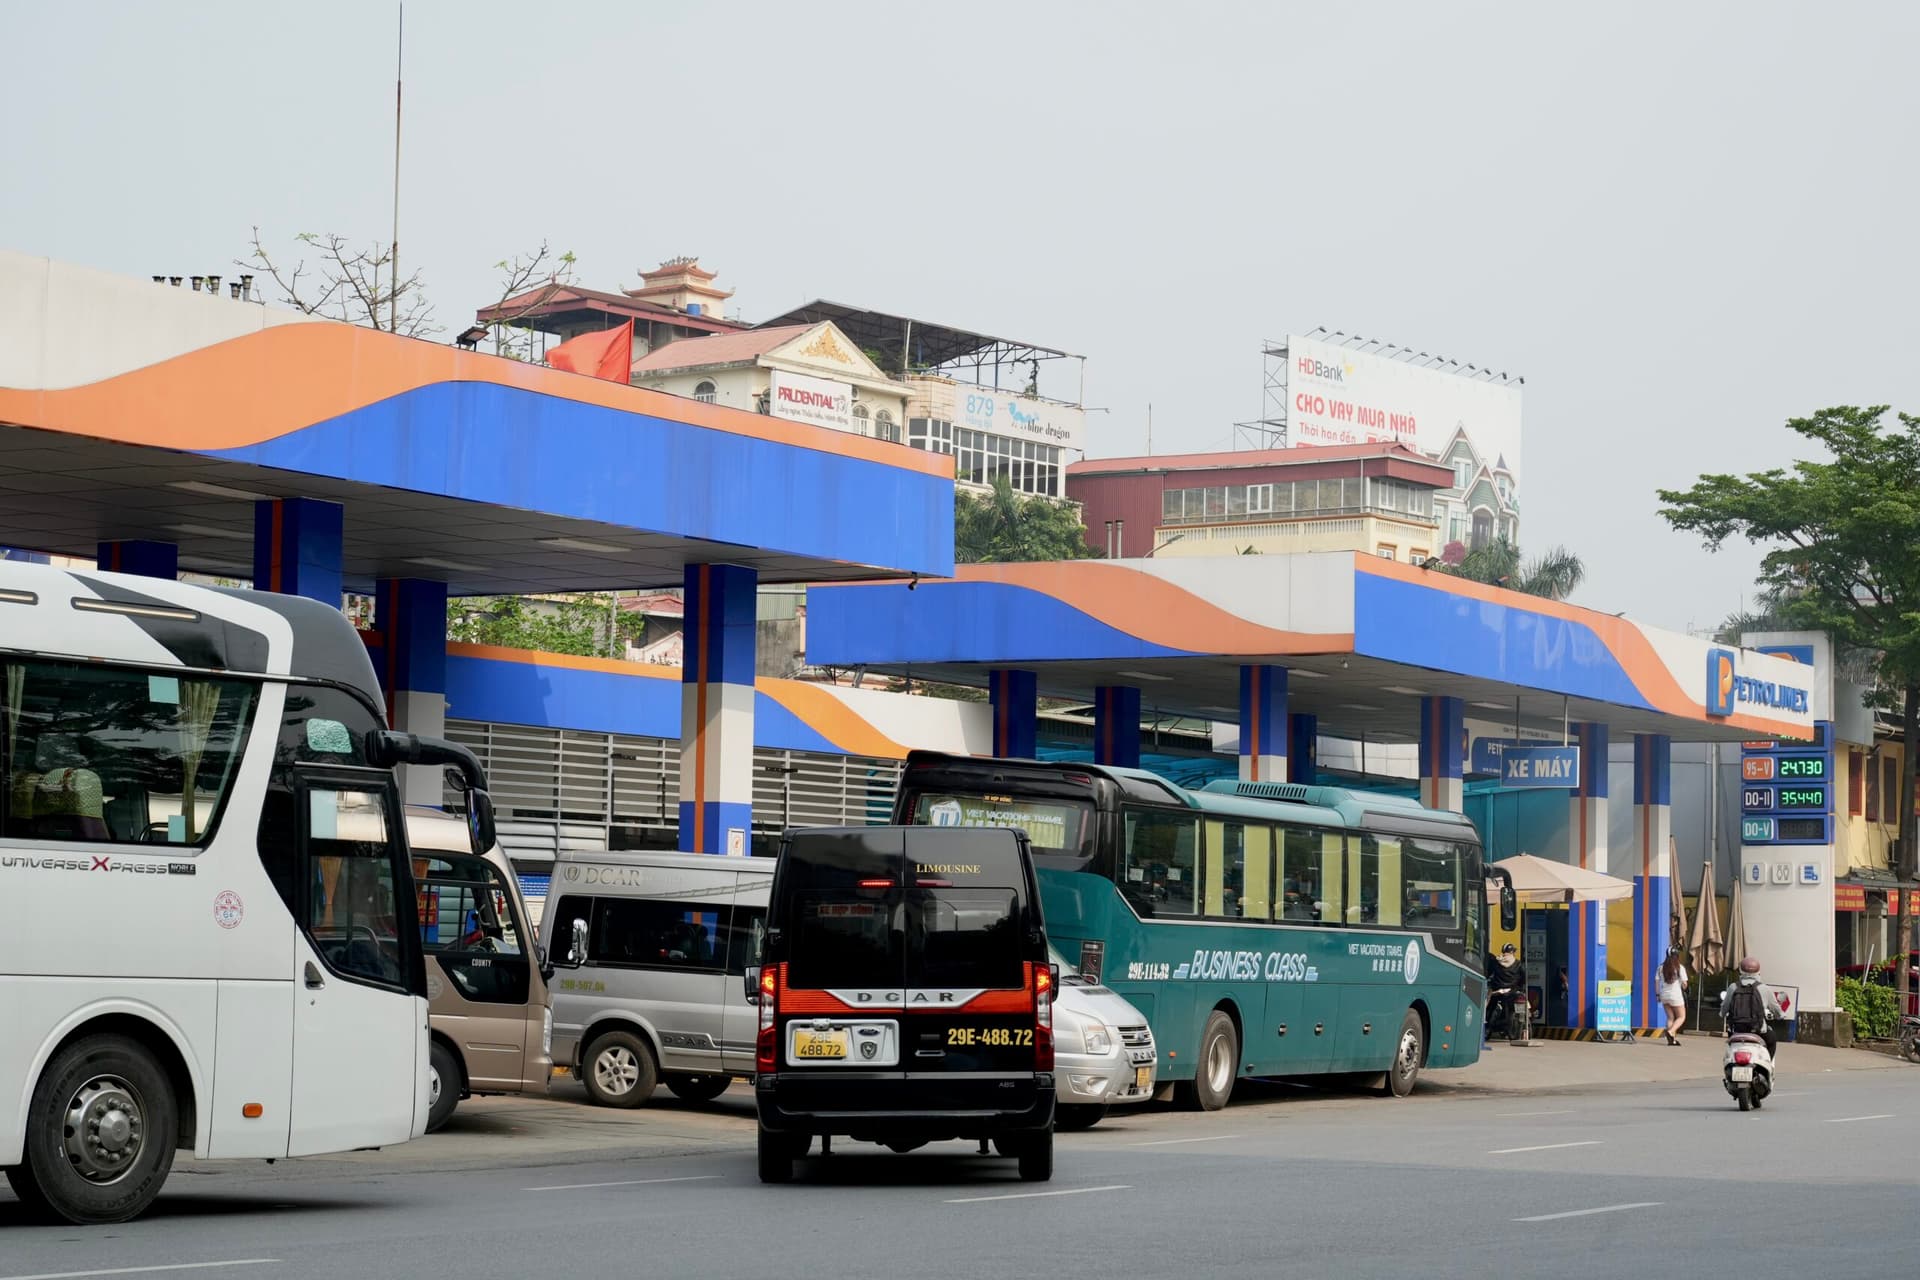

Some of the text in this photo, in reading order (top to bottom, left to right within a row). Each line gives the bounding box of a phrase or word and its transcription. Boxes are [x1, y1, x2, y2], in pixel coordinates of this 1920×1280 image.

[1298, 357, 1343, 382] HDBank
[778, 386, 834, 409] PRUDENTIAL
[966, 395, 994, 416] 879
[1296, 393, 1416, 435] CHO VAY MUA NHÀ
[1045, 423, 1070, 440] dragon
[1734, 675, 1808, 714] PETROLIMEX
[1508, 755, 1572, 778] XE MÁY
[1746, 761, 1770, 776] 95-V
[1745, 791, 1770, 806] DO-II
[1744, 822, 1770, 837] DO-V
[170, 864, 196, 875] NOBLE
[585, 867, 641, 886] DCAR
[916, 864, 982, 873] LIMOUSINE
[471, 958, 492, 967] COUNTY
[1190, 950, 1308, 982] BUSINESS CLASS
[810, 1033, 833, 1043] 29E
[948, 1028, 1033, 1046] 29E-488.72
[800, 1045, 841, 1056] 488.72
